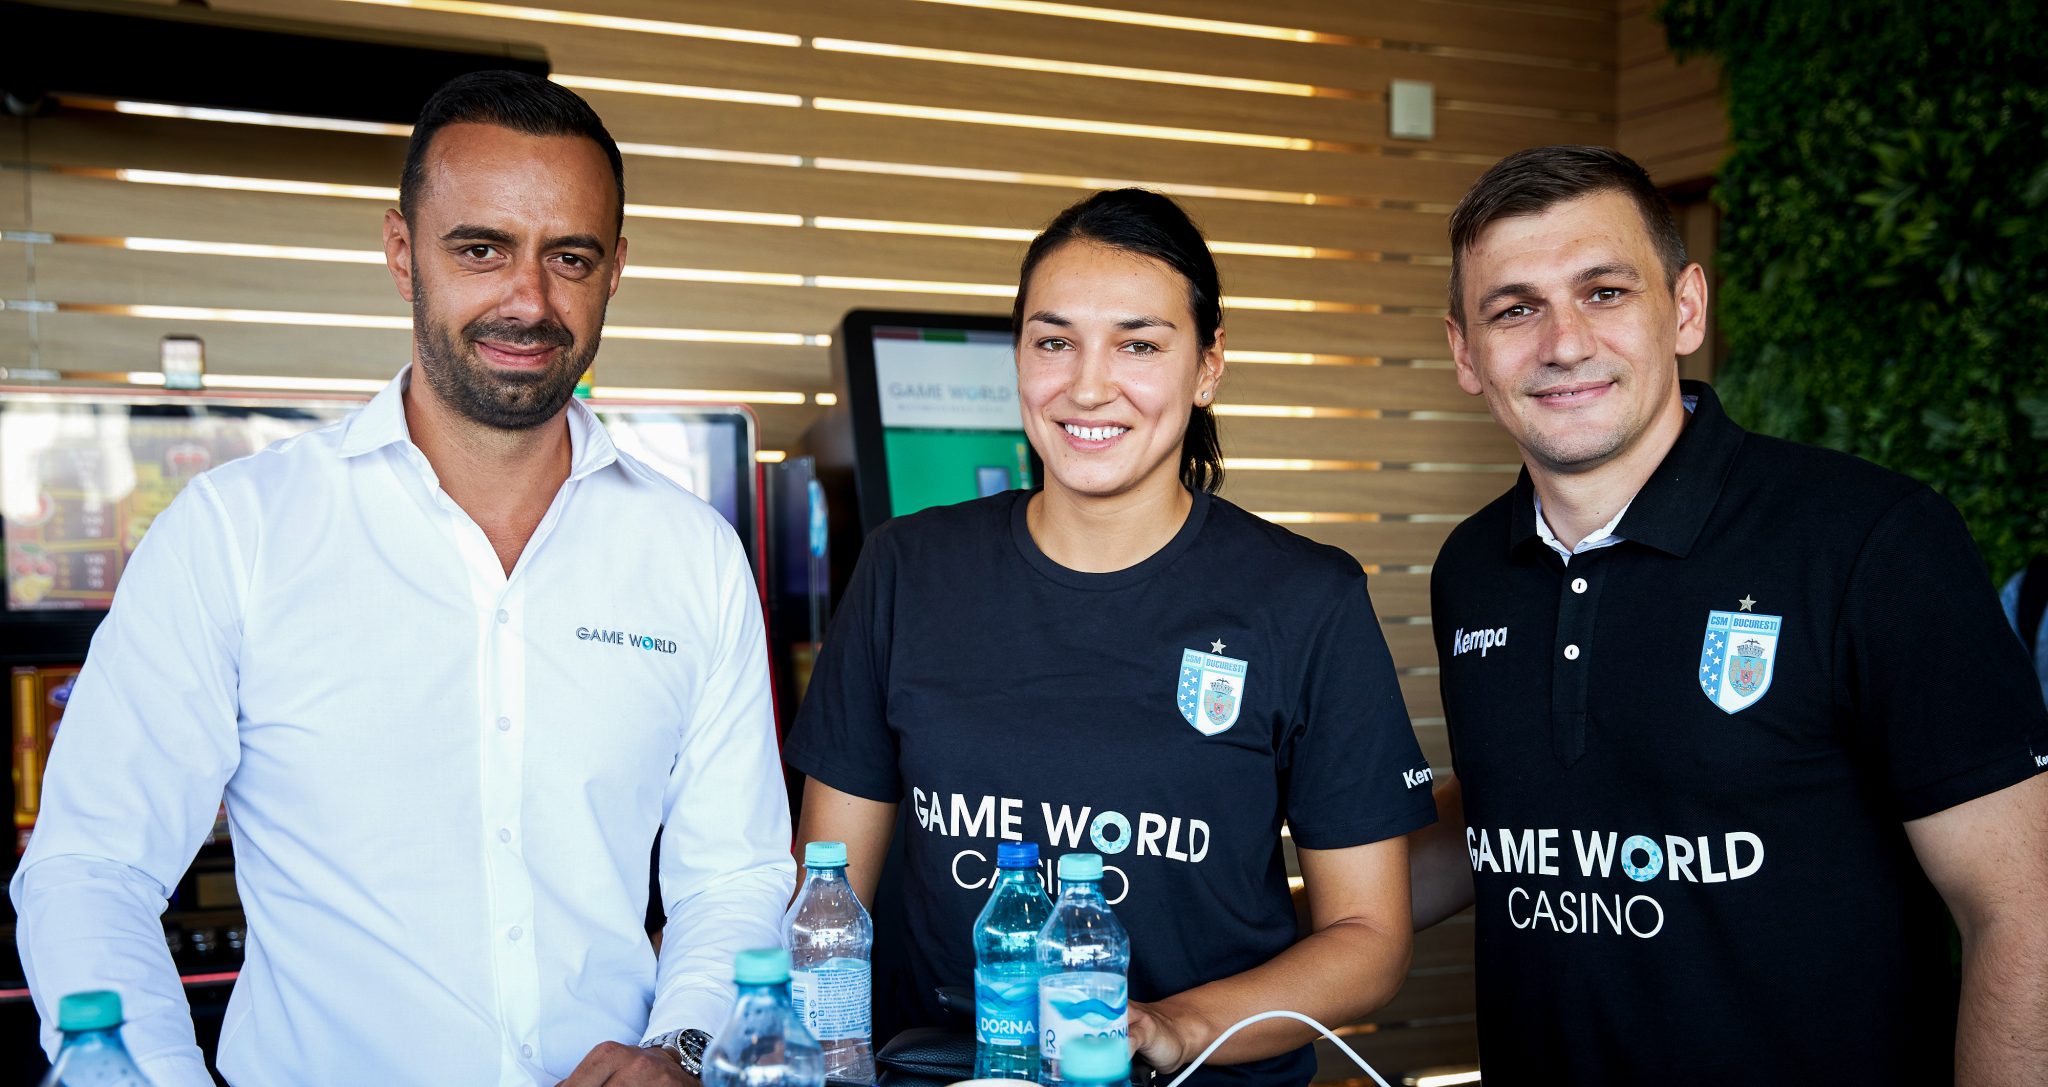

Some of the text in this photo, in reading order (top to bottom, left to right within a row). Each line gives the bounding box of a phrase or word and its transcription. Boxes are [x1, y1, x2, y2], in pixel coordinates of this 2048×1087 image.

[1710, 615, 1729, 626] CSM
[575, 626, 677, 654] GAME WORLD
[1453, 626, 1508, 657] Kempa
[2034, 755, 2048, 767] Ke
[913, 786, 1210, 863] GAME WORLD
[1466, 826, 1765, 884] GAME WORLD
[1508, 886, 1664, 938] CASINO
[981, 1016, 1036, 1034] DORNA
